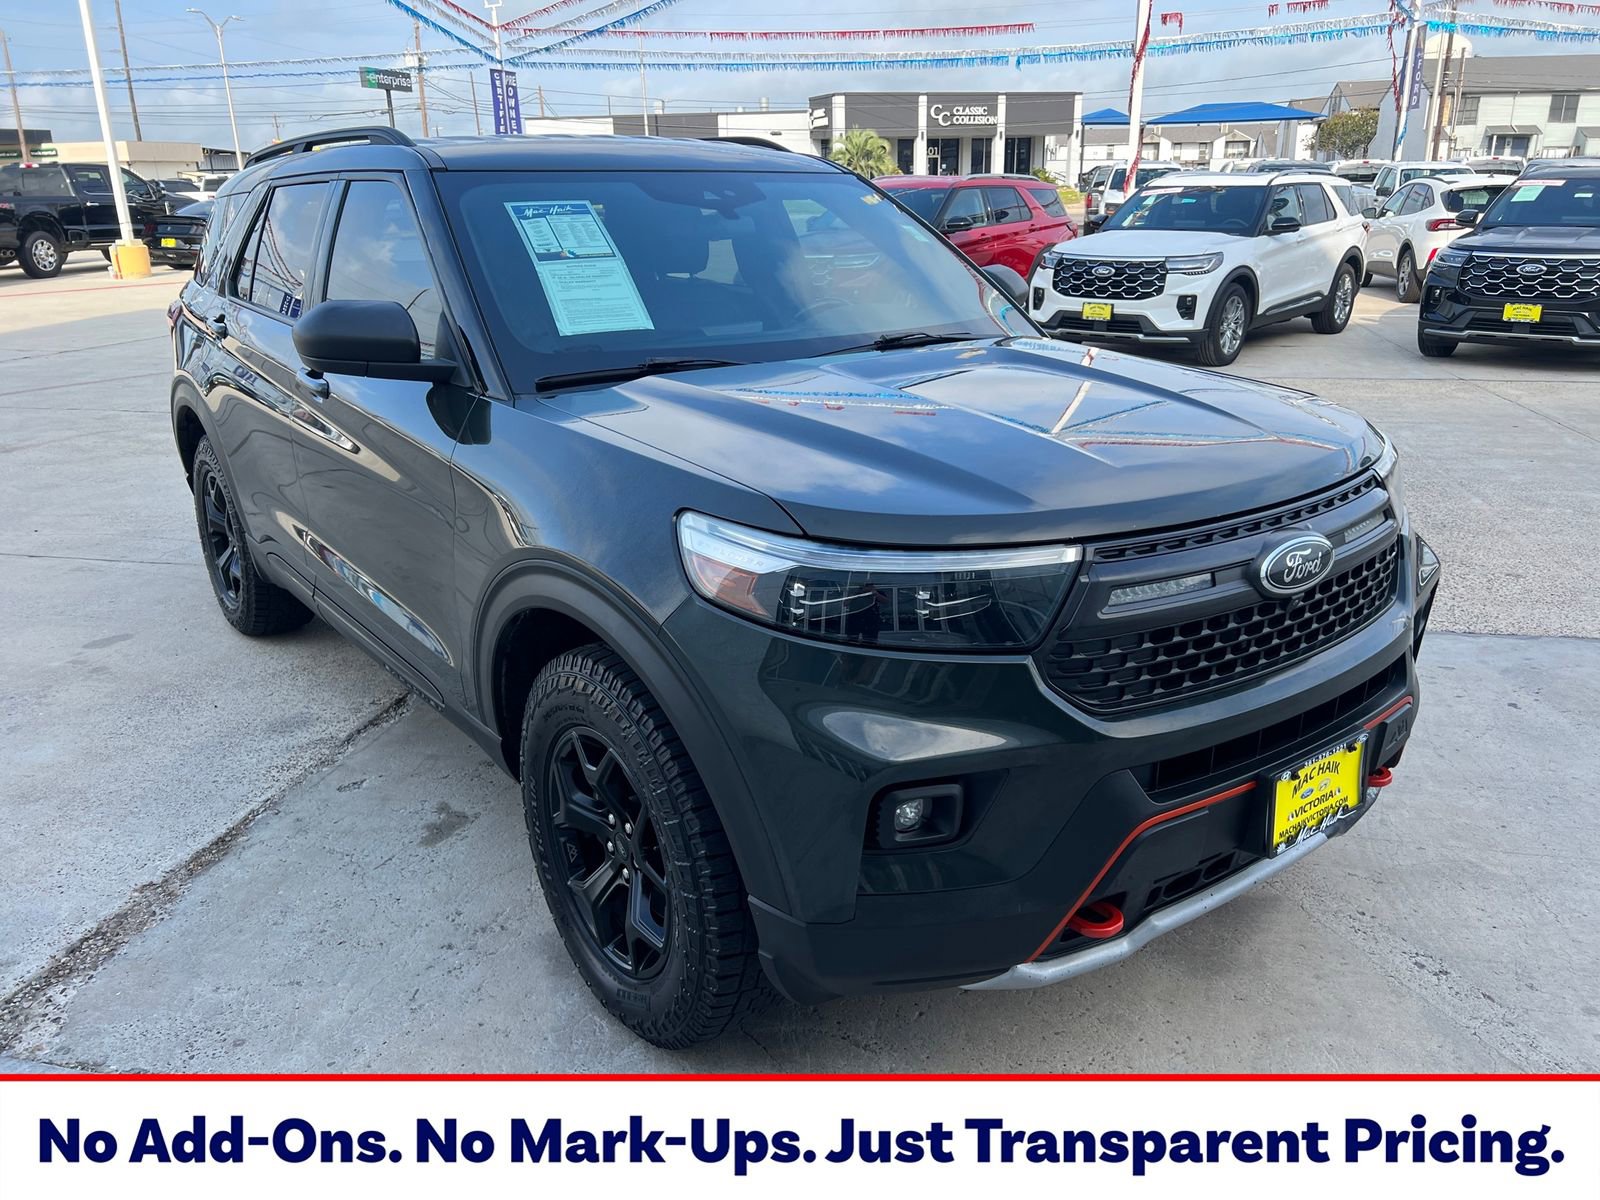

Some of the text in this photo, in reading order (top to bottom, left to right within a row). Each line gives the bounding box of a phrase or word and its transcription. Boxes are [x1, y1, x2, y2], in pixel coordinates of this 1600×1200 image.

[367, 72, 412, 88] enterprise
[1411, 59, 1423, 105] FORD
[494, 72, 506, 134] CERTIFIE
[953, 106, 988, 116] CLASSIC
[952, 115, 998, 125] COLLISION
[1283, 548, 1323, 583] Ford
[1291, 766, 1316, 799] MAC
[1317, 760, 1341, 777] HAIK
[1293, 790, 1334, 818] VICTORIA
